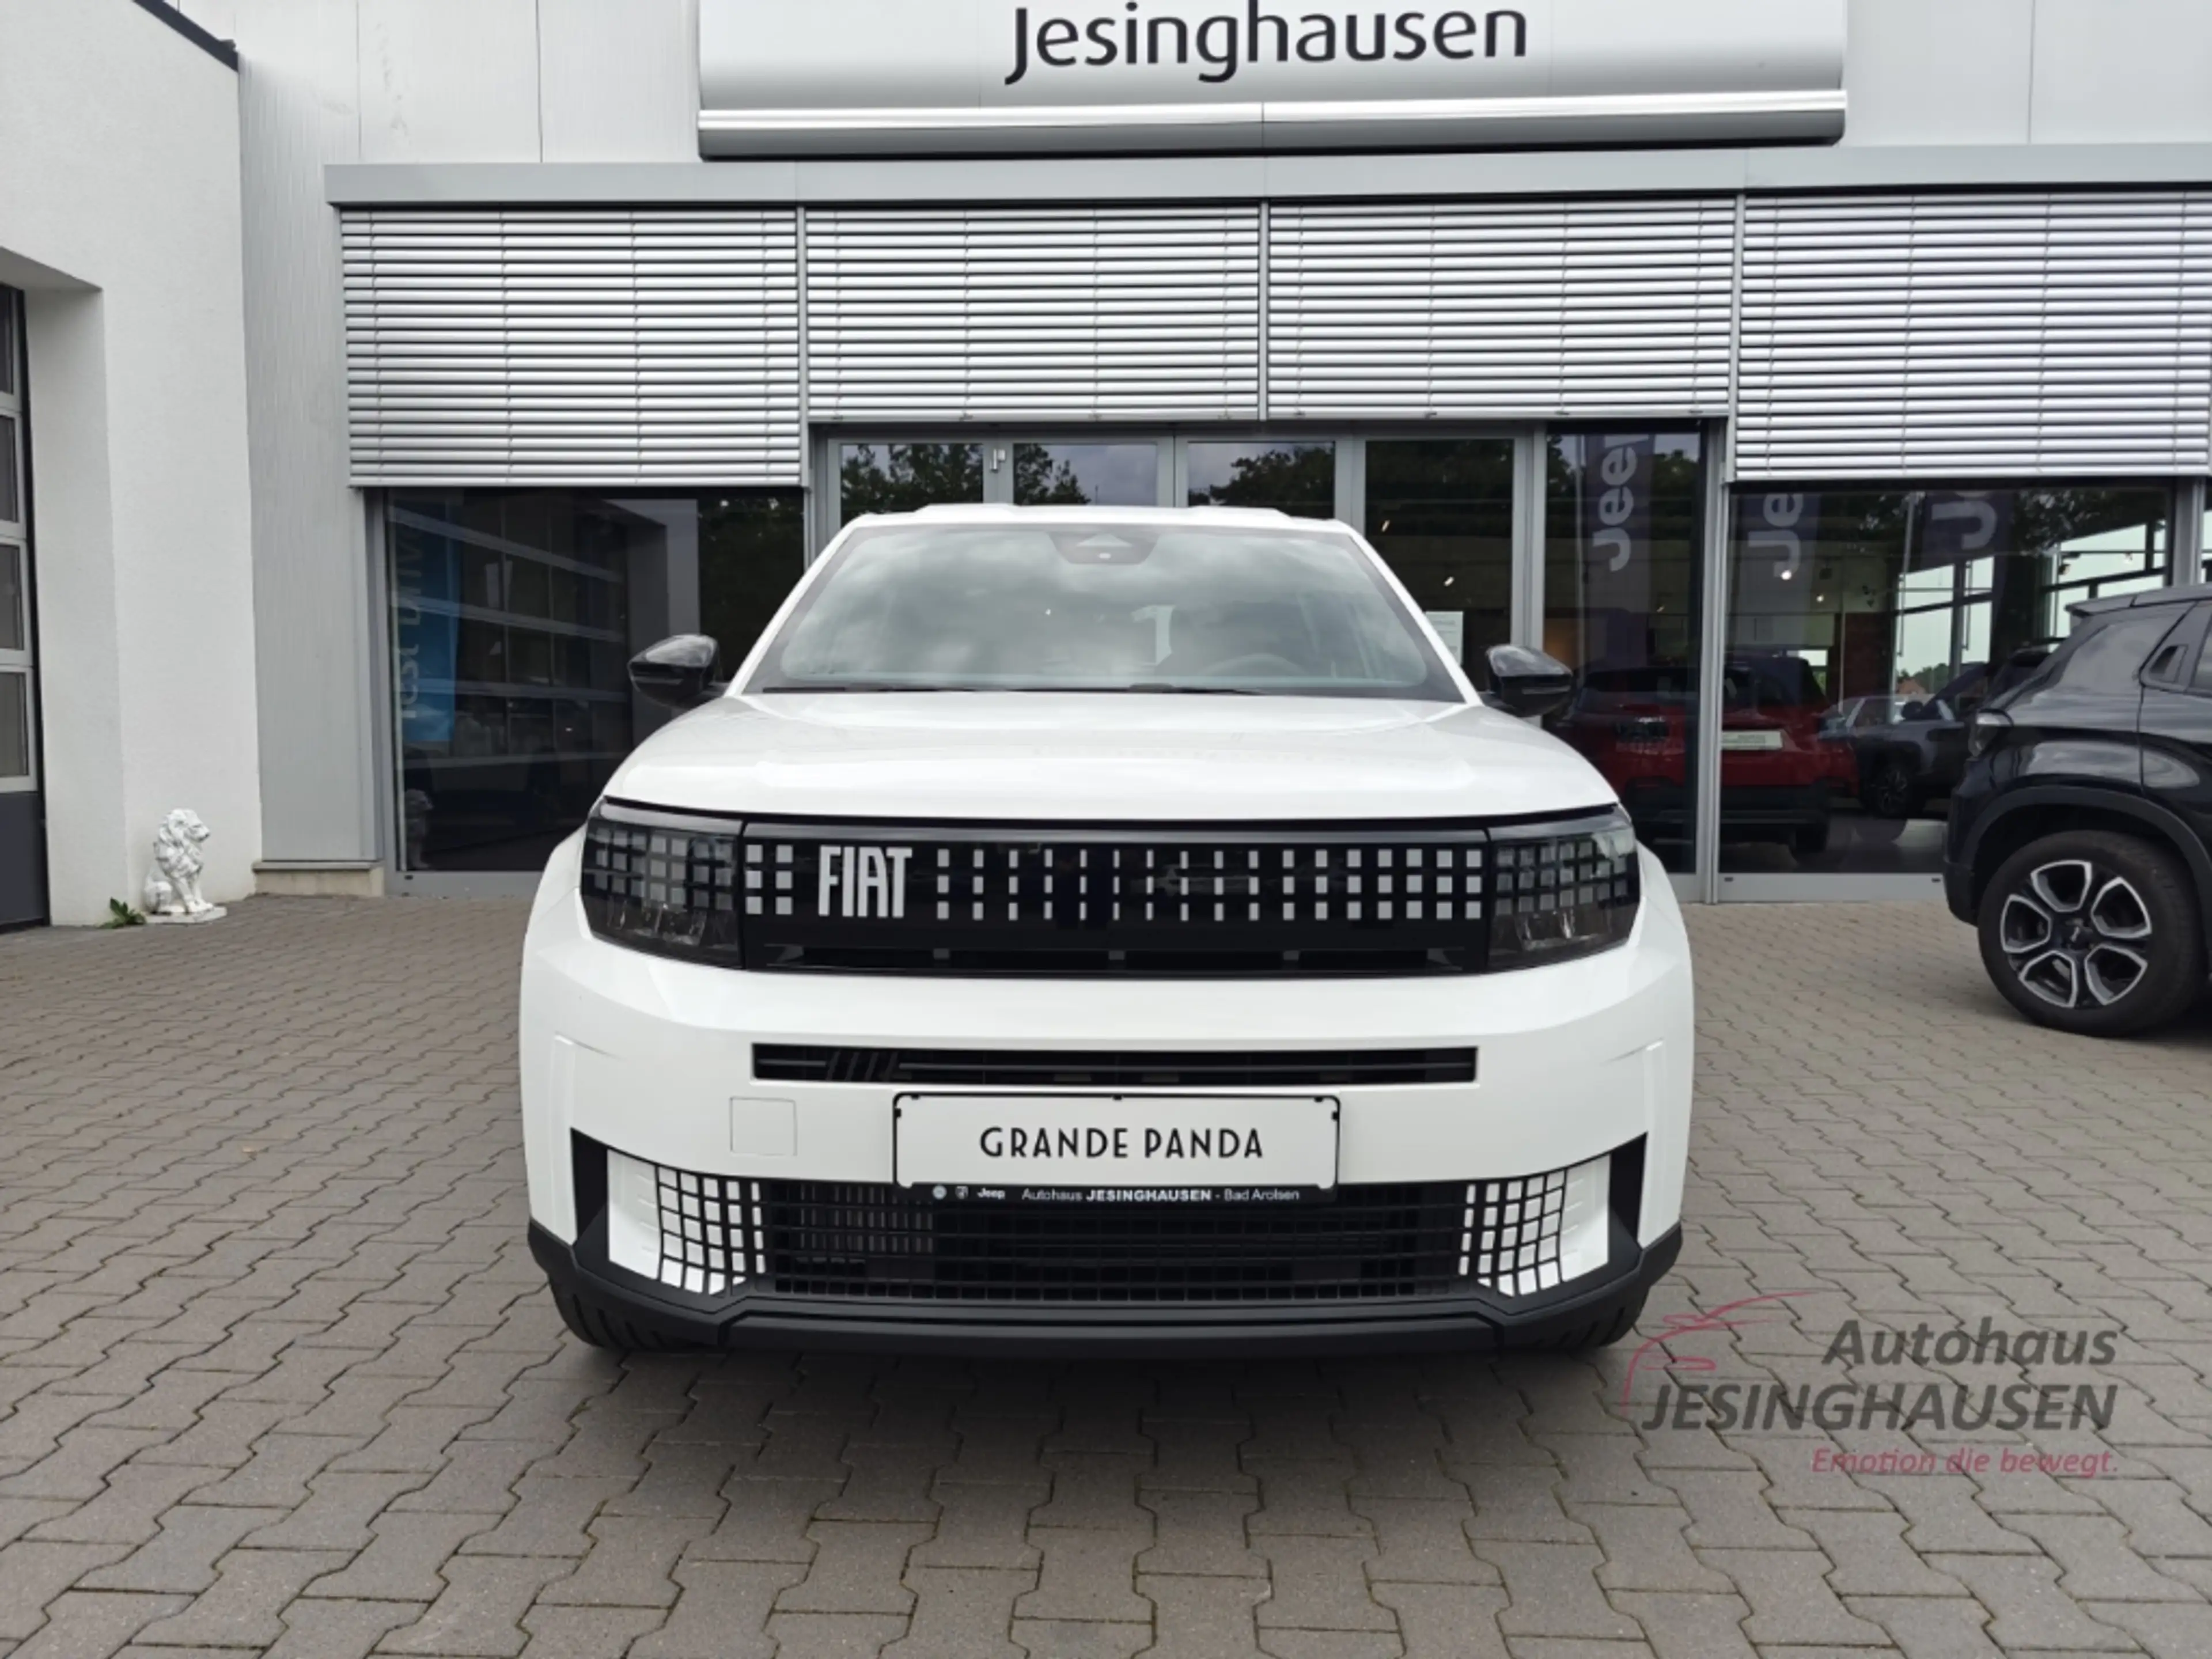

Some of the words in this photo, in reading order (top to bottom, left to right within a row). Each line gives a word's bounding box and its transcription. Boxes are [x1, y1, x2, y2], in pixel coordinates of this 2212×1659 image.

[1005, 0, 1528, 85] Jesinghausen
[1931, 491, 1997, 550] J
[819, 844, 912, 918] FIAT
[980, 1127, 1128, 1158] GRANDE
[1145, 1128, 1264, 1158] PANDA
[977, 1187, 1006, 1200] Jeep
[1021, 1188, 1083, 1201] Autohaus
[1086, 1189, 1212, 1202] JESINGHAUSEN
[1224, 1188, 1249, 1201] Bad
[1251, 1188, 1300, 1201] Arolsen
